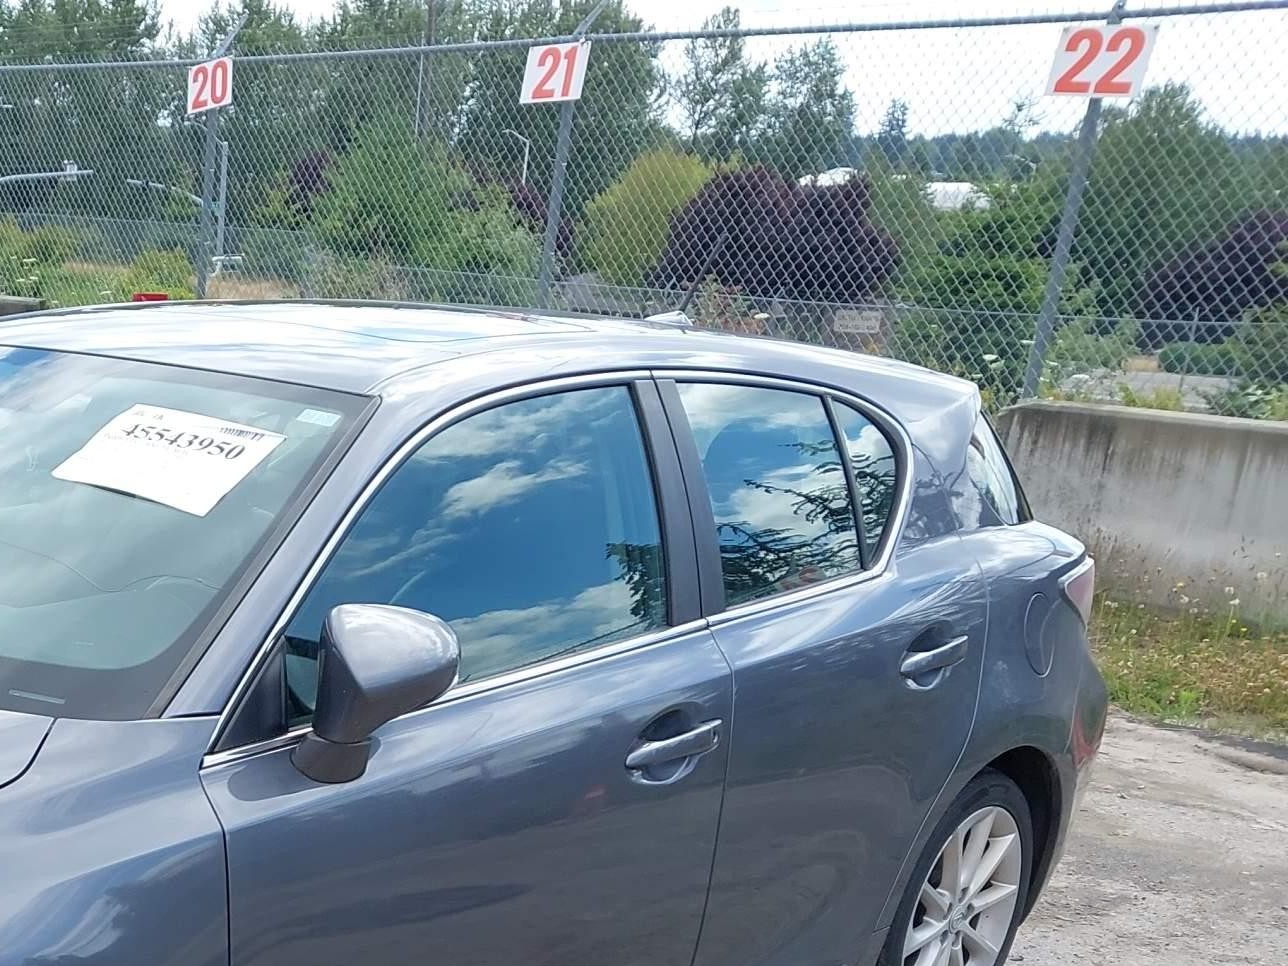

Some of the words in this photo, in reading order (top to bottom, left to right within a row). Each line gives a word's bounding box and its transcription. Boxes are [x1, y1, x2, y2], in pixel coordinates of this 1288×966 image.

[191, 60, 228, 109] 20
[531, 46, 580, 99] 21
[1053, 27, 1146, 94] 22
[121, 423, 247, 460] 45543950
